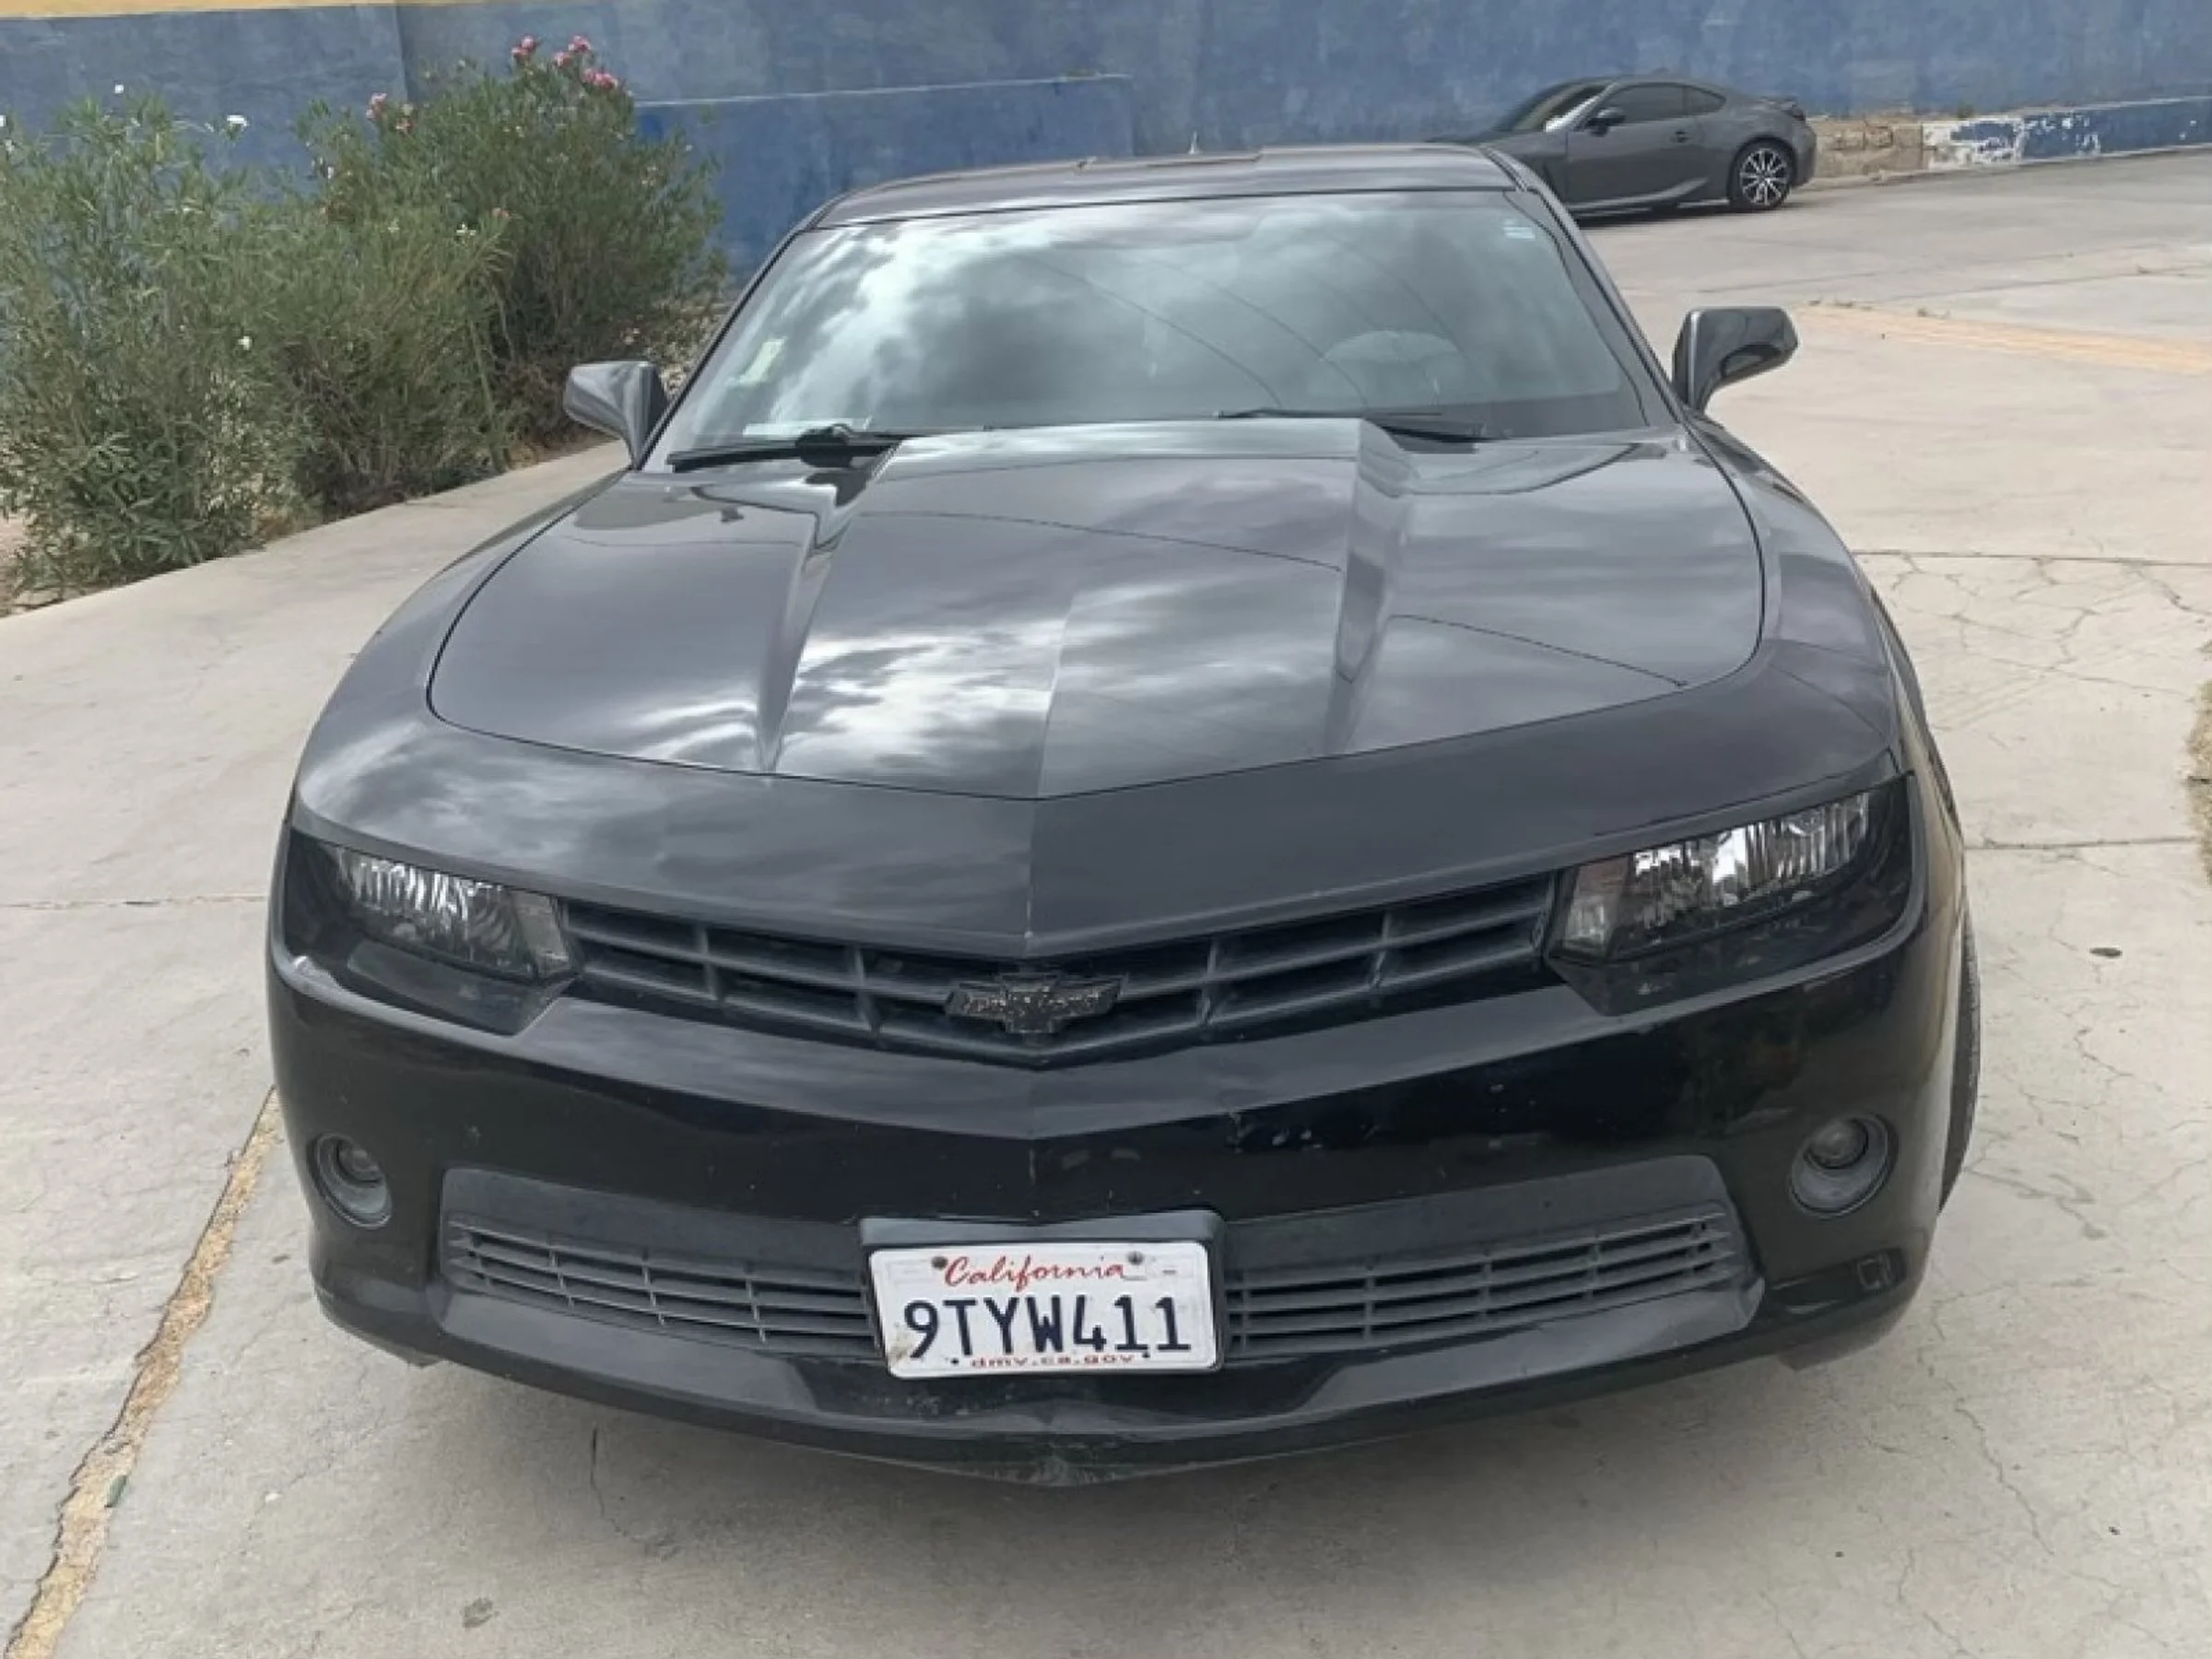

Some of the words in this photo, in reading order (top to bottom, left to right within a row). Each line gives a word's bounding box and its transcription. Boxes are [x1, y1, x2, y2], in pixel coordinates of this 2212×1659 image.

[944, 1254, 1125, 1290] California
[903, 1294, 1191, 1359] 9TYW411
[971, 1353, 1135, 1369] dmv.ca.gov
